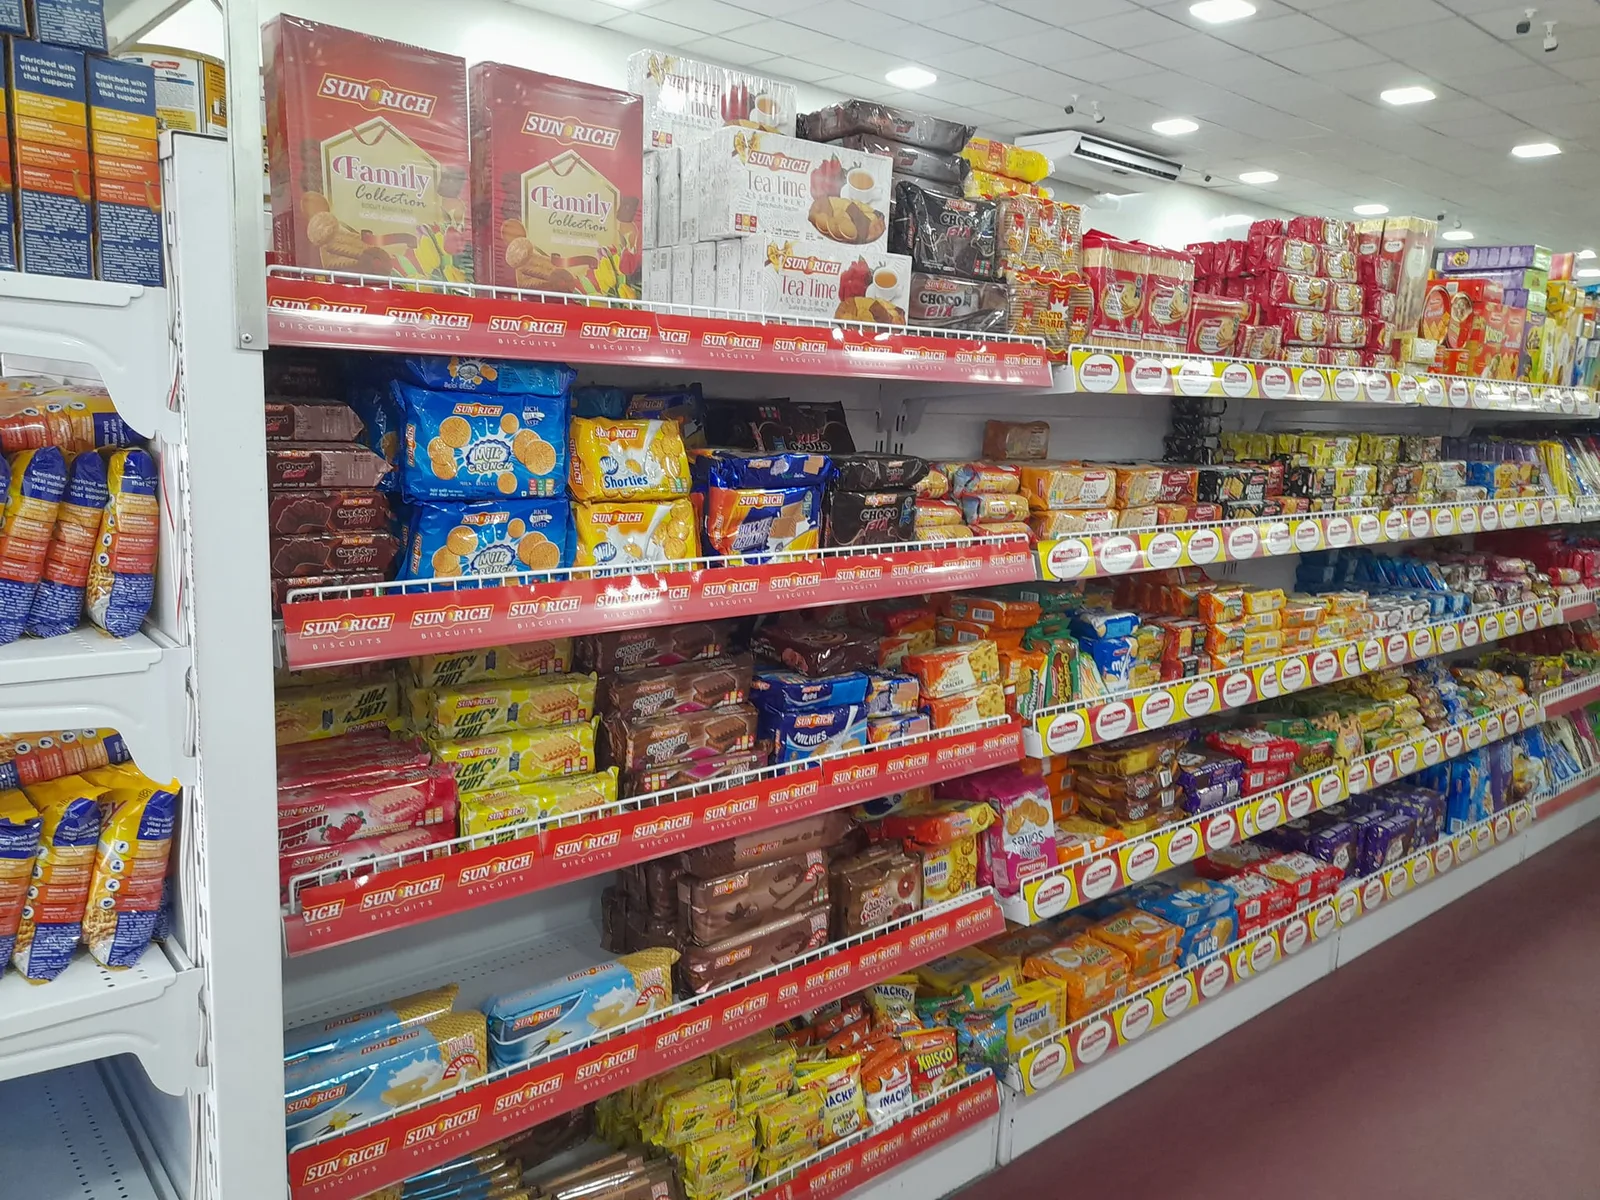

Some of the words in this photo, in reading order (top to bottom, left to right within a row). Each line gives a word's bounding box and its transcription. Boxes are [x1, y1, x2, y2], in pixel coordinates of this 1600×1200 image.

[20, 55, 56, 67] Enriched
[58, 64, 76, 72] with
[20, 64, 38, 72] vital
[40, 67, 76, 80] nutrients
[96, 72, 129, 83] Enriched
[131, 79, 147, 87] with
[23, 73, 41, 82] that
[43, 76, 74, 89] support
[97, 82, 113, 91] vital
[115, 85, 147, 96] nutrients
[99, 90, 115, 98] that
[117, 93, 145, 104] support
[323, 78, 370, 101] SUN
[379, 91, 431, 114] RICH
[526, 115, 565, 136] SUN
[572, 126, 617, 146] RICH
[750, 152, 774, 166] SUN
[780, 160, 809, 172] RICH
[332, 155, 431, 199] Family
[747, 170, 771, 193] Tea
[777, 176, 806, 198] Time
[355, 184, 427, 209] Collection
[531, 186, 612, 223] Family
[548, 212, 608, 232] Collection
[785, 257, 808, 270] SUN
[812, 260, 840, 274] RICH
[781, 274, 804, 296] Tea
[809, 280, 836, 300] Time
[919, 292, 962, 305] CHOCO
[395, 331, 461, 342] BISCUITS
[498, 338, 557, 347] BISCUITS
[589, 343, 642, 352] BISCUITS
[1085, 365, 1113, 374] Maliban
[455, 405, 474, 413] SUN
[479, 406, 502, 415] RICH
[474, 447, 503, 461] Milk
[468, 462, 513, 473] CRUNCH
[31, 477, 46, 487] vital
[32, 470, 61, 483] Enriched
[604, 474, 648, 488] Shorties
[31, 483, 47, 492] that
[70, 491, 85, 499] that
[592, 513, 613, 523] SUN
[617, 513, 642, 522] RICH
[860, 510, 898, 521] CHOCO
[478, 552, 508, 566] Milk
[593, 542, 616, 562] Milk
[511, 602, 539, 617] SUN
[544, 599, 579, 612] RICH
[413, 612, 446, 626] SUN
[453, 608, 490, 621] RICH
[517, 618, 572, 629] BISCUITS
[304, 620, 339, 635] SUN
[348, 616, 390, 632] RICH
[421, 628, 482, 639] BISCUITS
[312, 638, 382, 650] BISCUITS
[432, 669, 465, 686] PUFF
[1187, 691, 1209, 700] Maliban
[1146, 700, 1170, 710] Maliban
[1100, 713, 1125, 722] Maliban
[453, 722, 487, 739] PUFF
[1051, 724, 1077, 734] Maliban
[794, 730, 826, 745] MILKIES
[457, 773, 488, 791] PUFF
[770, 791, 790, 803] SUN
[795, 783, 817, 797] RICH
[706, 808, 726, 819] SUN
[731, 799, 756, 813] RICH
[635, 823, 658, 837] SUN
[663, 817, 691, 831] RICH
[556, 842, 581, 855] SUN
[588, 833, 617, 848] RICH
[640, 833, 686, 848] BISCUITS
[1172, 835, 1193, 848] Maliban
[562, 852, 612, 867] BISCUITS
[1132, 852, 1154, 864] Maliban
[461, 866, 492, 883] SUN
[496, 855, 530, 873] RICH
[924, 861, 947, 877] Vanilla
[1086, 866, 1111, 880] Maliban
[468, 875, 524, 895] BISCUITS
[1038, 883, 1064, 900] Maliban
[363, 893, 395, 908] SUN
[402, 879, 441, 898] RICH
[371, 900, 433, 920] BISCUITS
[1013, 1002, 1047, 1029] Custard
[917, 1047, 953, 1072] KRISCO
[927, 1066, 946, 1079] Bites
[496, 1095, 524, 1111] SUN
[528, 1078, 560, 1097] RICH
[405, 1124, 436, 1145] SUN
[444, 1109, 478, 1128] RICH
[413, 1130, 471, 1155] BISCUITS
[305, 1160, 340, 1182] SUN
[347, 1143, 386, 1162] RICH
[314, 1165, 377, 1194] BISCUITS
